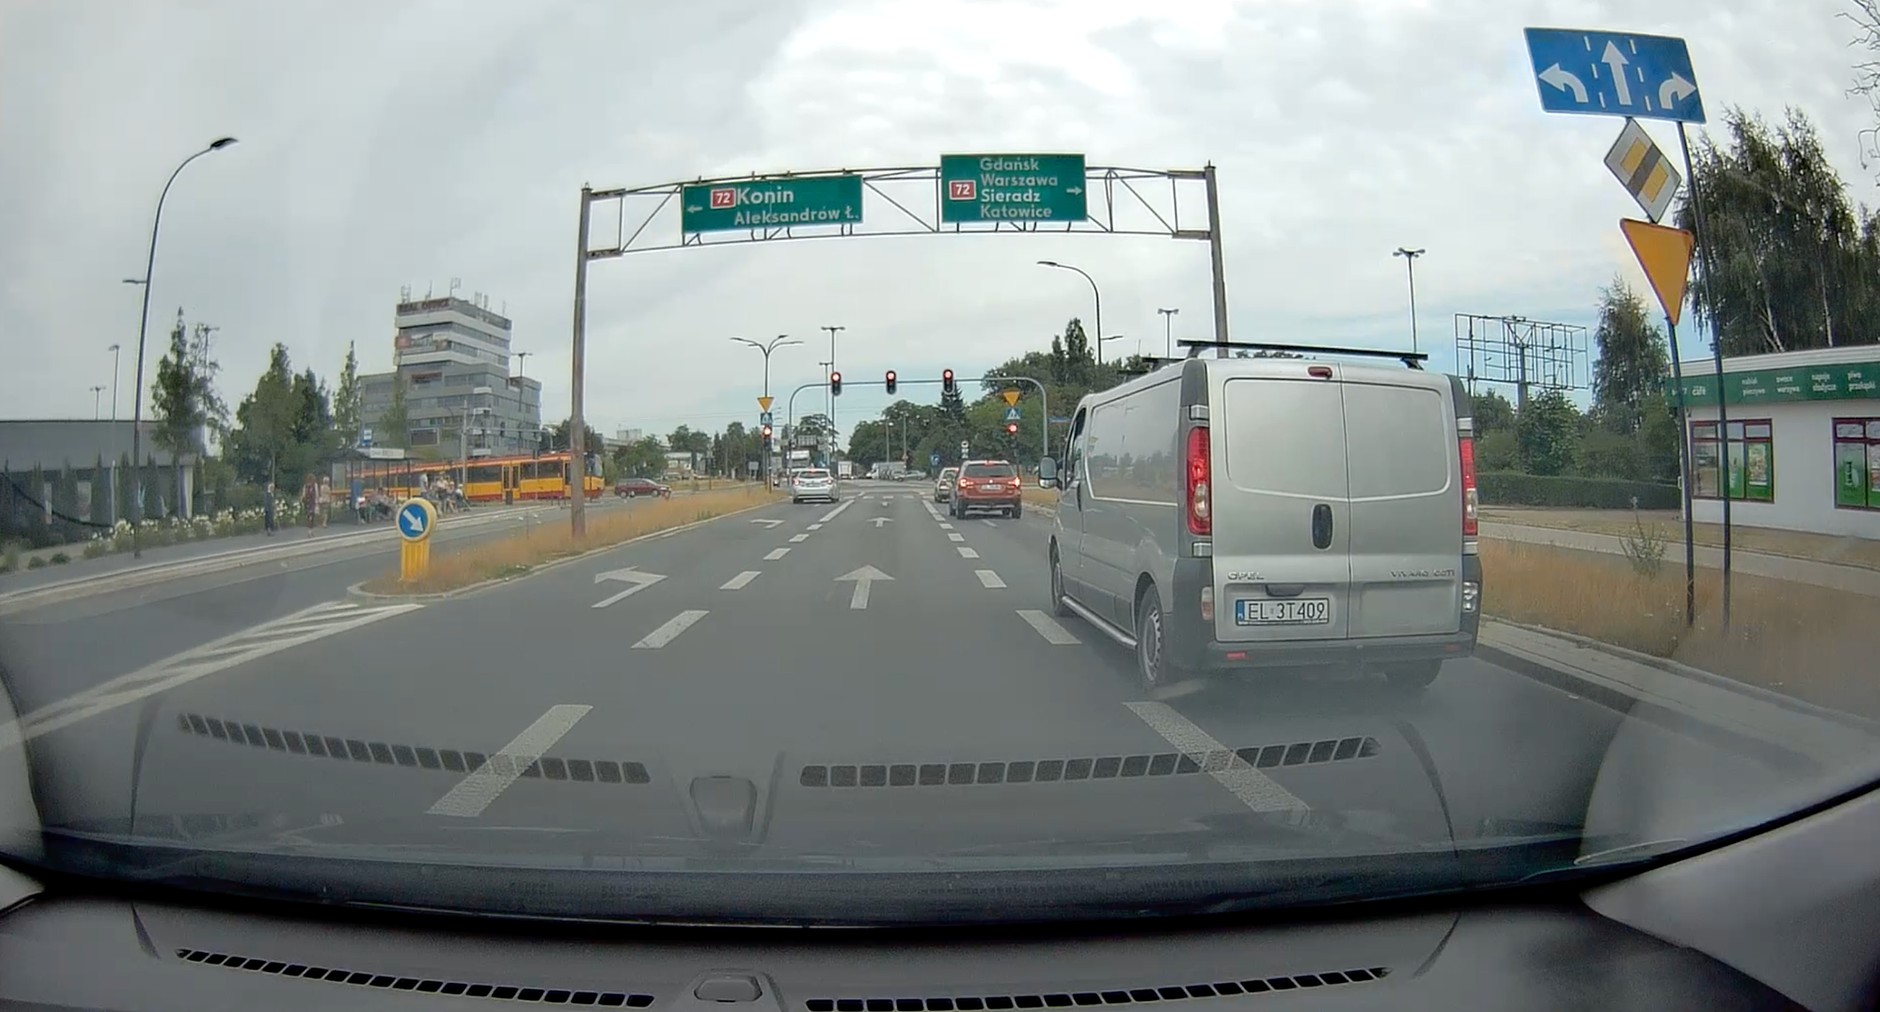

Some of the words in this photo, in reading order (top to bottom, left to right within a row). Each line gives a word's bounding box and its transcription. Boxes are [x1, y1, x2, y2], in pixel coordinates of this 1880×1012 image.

[980, 157, 1039, 171] Gdańsk
[981, 174, 1058, 186] Warszawa
[716, 192, 731, 204] 72
[737, 186, 794, 204] Konin
[956, 184, 970, 196] 72
[981, 189, 1040, 202] Sieradz
[734, 206, 840, 225] Aleksandrów
[844, 205, 859, 219] Ł.
[981, 205, 1052, 218] Katowice
[1227, 571, 1264, 580] OPEL
[1248, 602, 1269, 620] EL
[1276, 602, 1325, 620] 3T409
